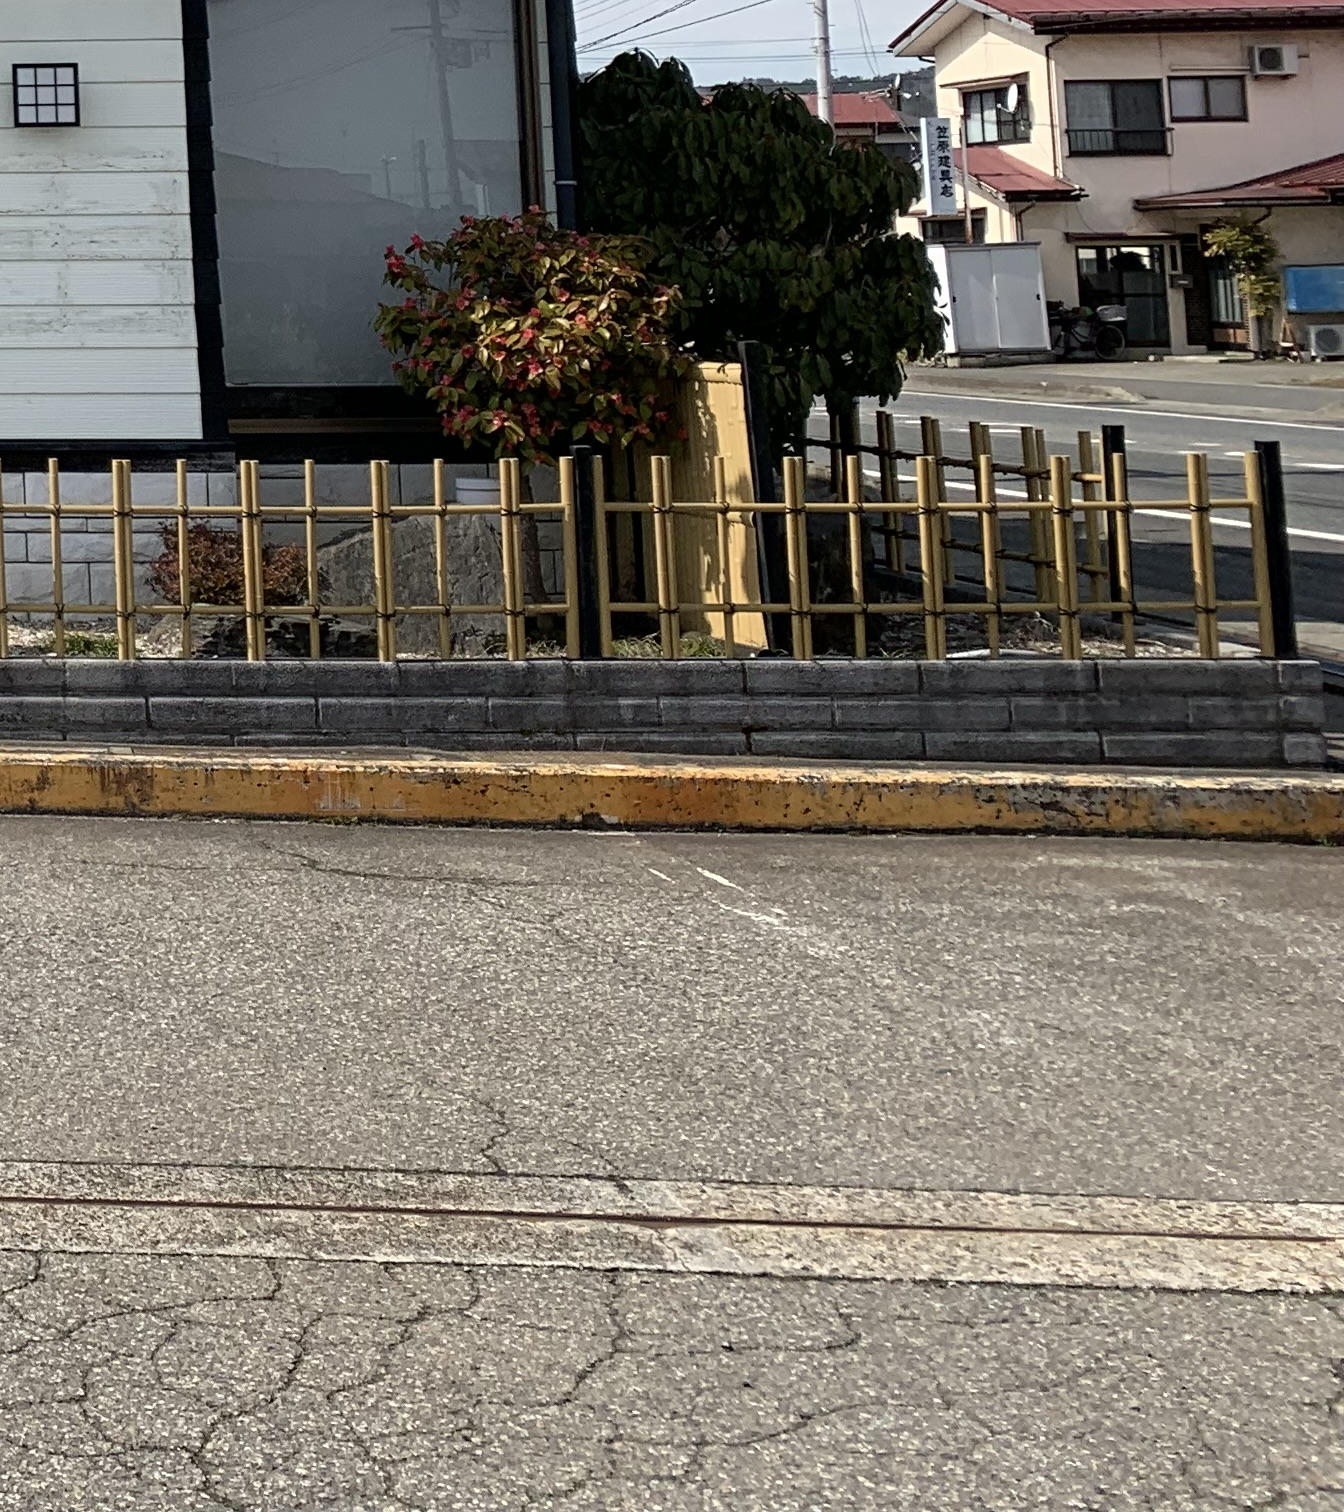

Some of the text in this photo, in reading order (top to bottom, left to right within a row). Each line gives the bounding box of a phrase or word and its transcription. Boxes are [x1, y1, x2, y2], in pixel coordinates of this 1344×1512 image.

[936, 125, 954, 198] 笠原建具店
